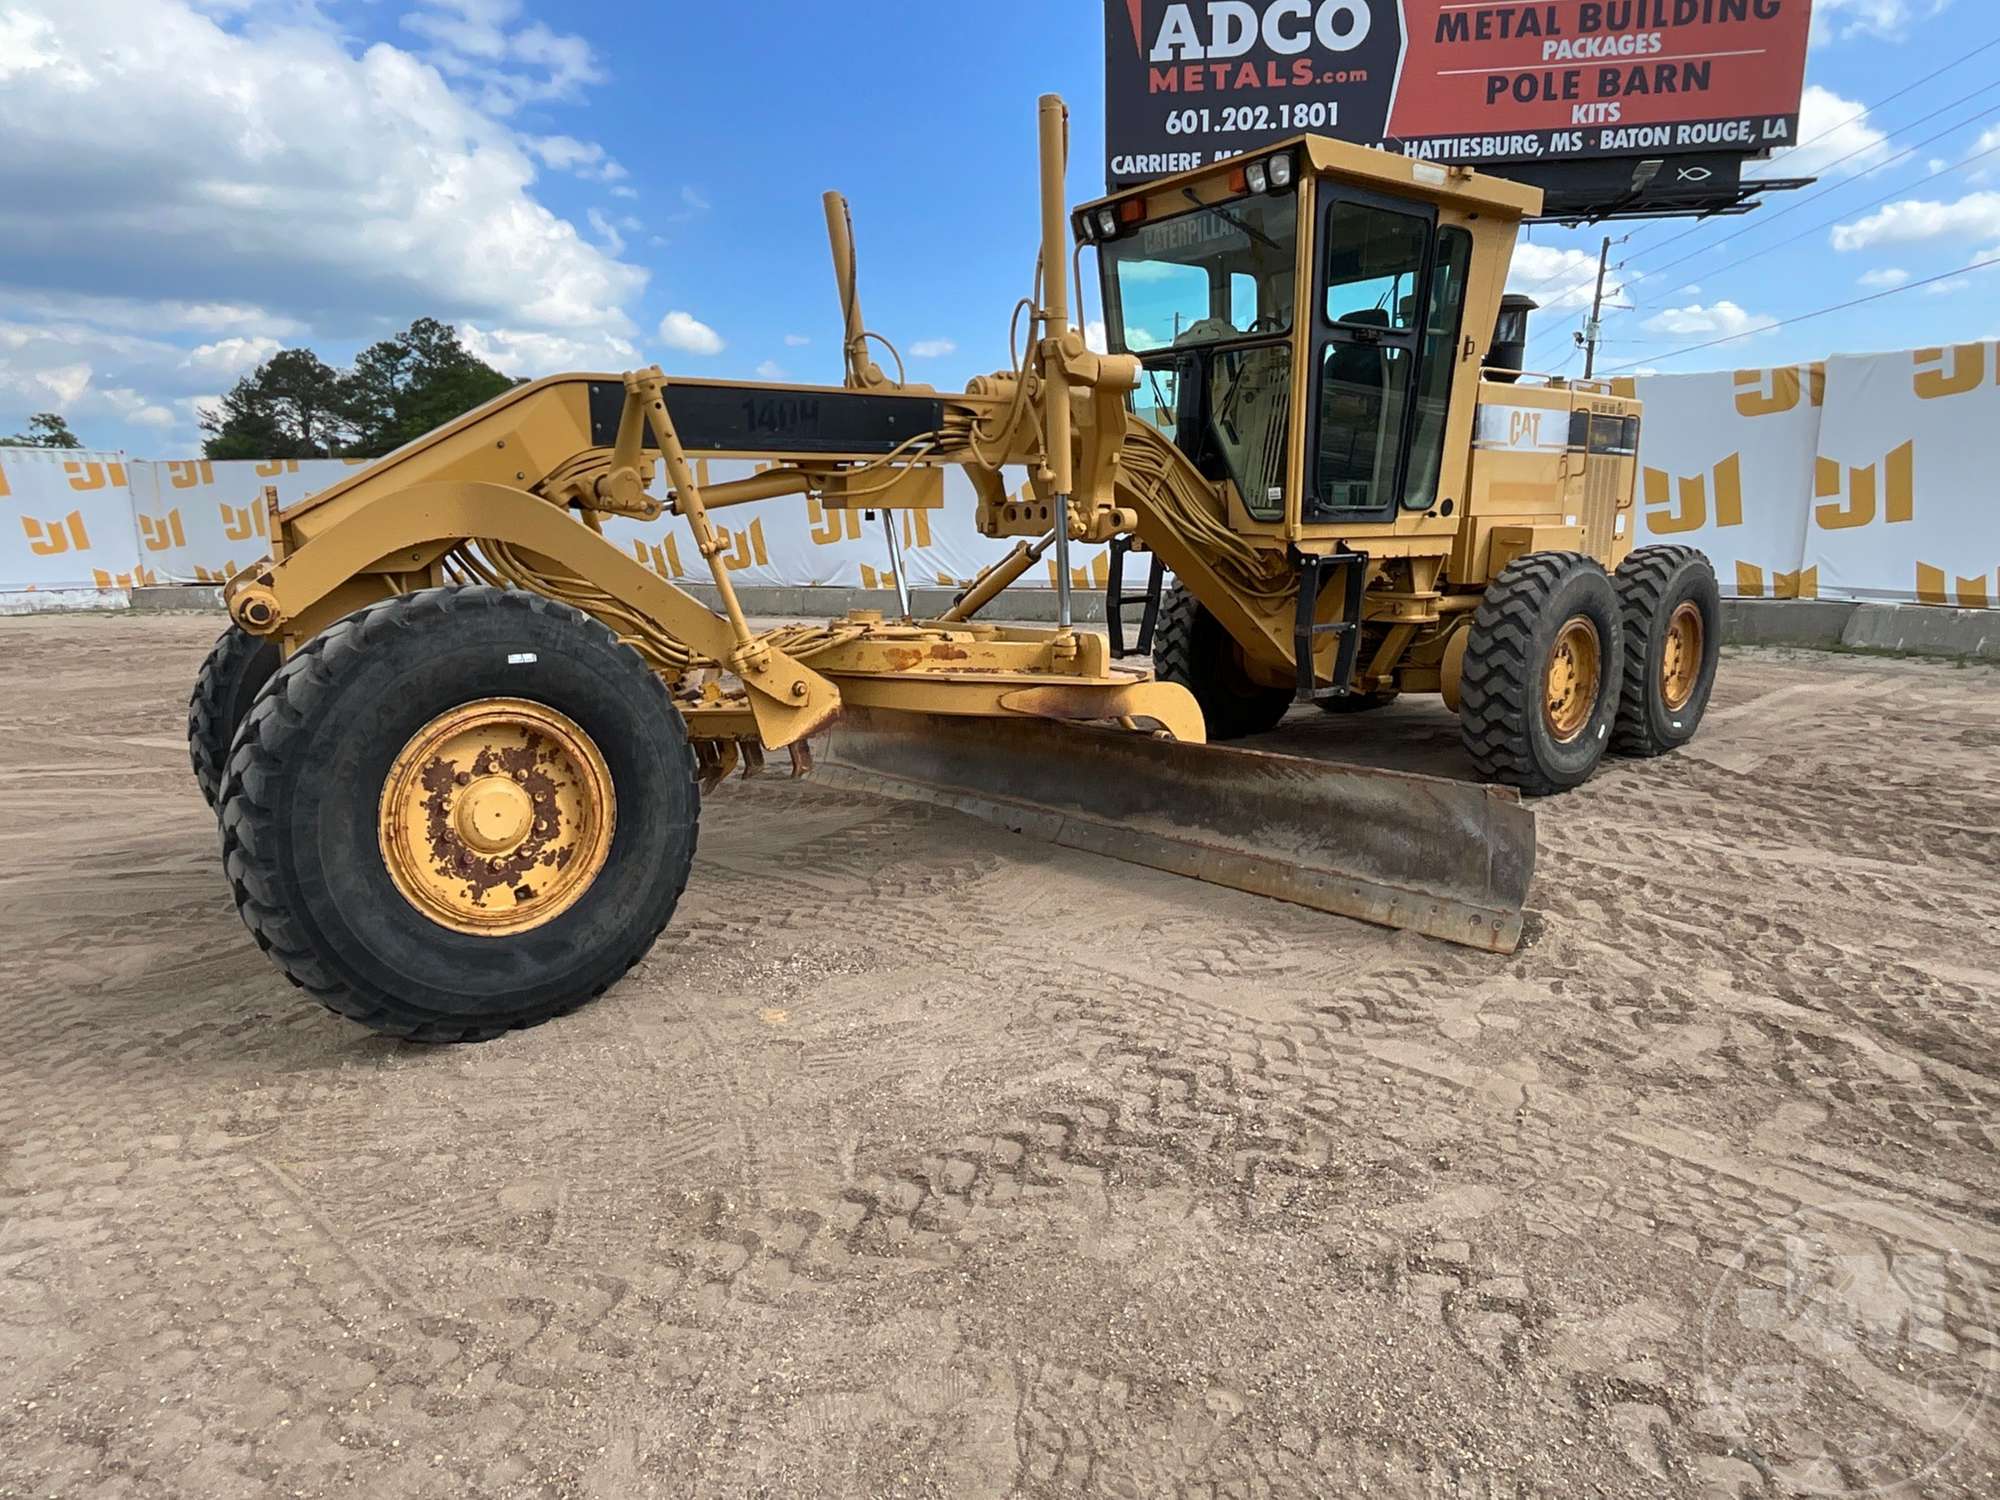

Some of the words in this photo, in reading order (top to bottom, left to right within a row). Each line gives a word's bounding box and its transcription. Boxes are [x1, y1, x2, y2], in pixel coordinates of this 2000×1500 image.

[1150, 0, 1371, 62] ADCO
[1435, 5, 1561, 43] METAL
[1579, 0, 1781, 34] BUILDING
[1542, 33, 1663, 60] PACKAGES
[1149, 58, 1368, 94] METALS.com
[1486, 70, 1581, 104] POLE
[1599, 61, 1711, 97] BARN
[1165, 101, 1338, 135] 601.202.1801
[1571, 102, 1621, 125] KITS
[1403, 134, 1545, 159] HATTIESBURG,
[1549, 131, 1583, 153] MS
[1600, 128, 1670, 150] BATON
[1676, 121, 1756, 146] ROUGE,
[1762, 118, 1788, 139] LA
[1510, 410, 1542, 447] CAT
